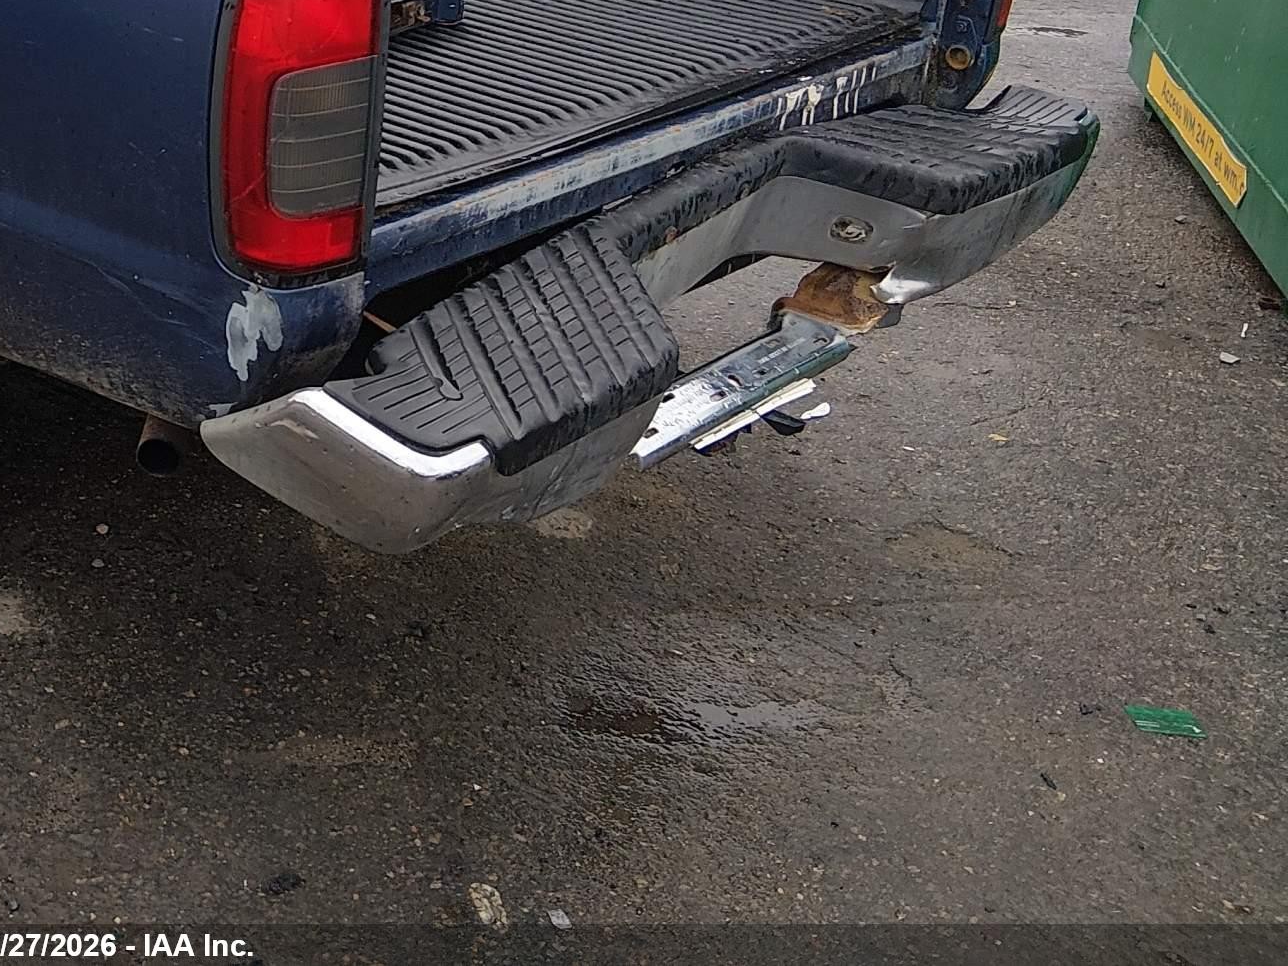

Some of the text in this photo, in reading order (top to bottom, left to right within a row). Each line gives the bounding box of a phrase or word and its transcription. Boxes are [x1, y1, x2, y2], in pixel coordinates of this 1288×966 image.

[1161, 80, 1183, 120] Access
[1182, 104, 1196, 133] WM
[1195, 122, 1215, 159] 24/7
[1214, 151, 1223, 172] at
